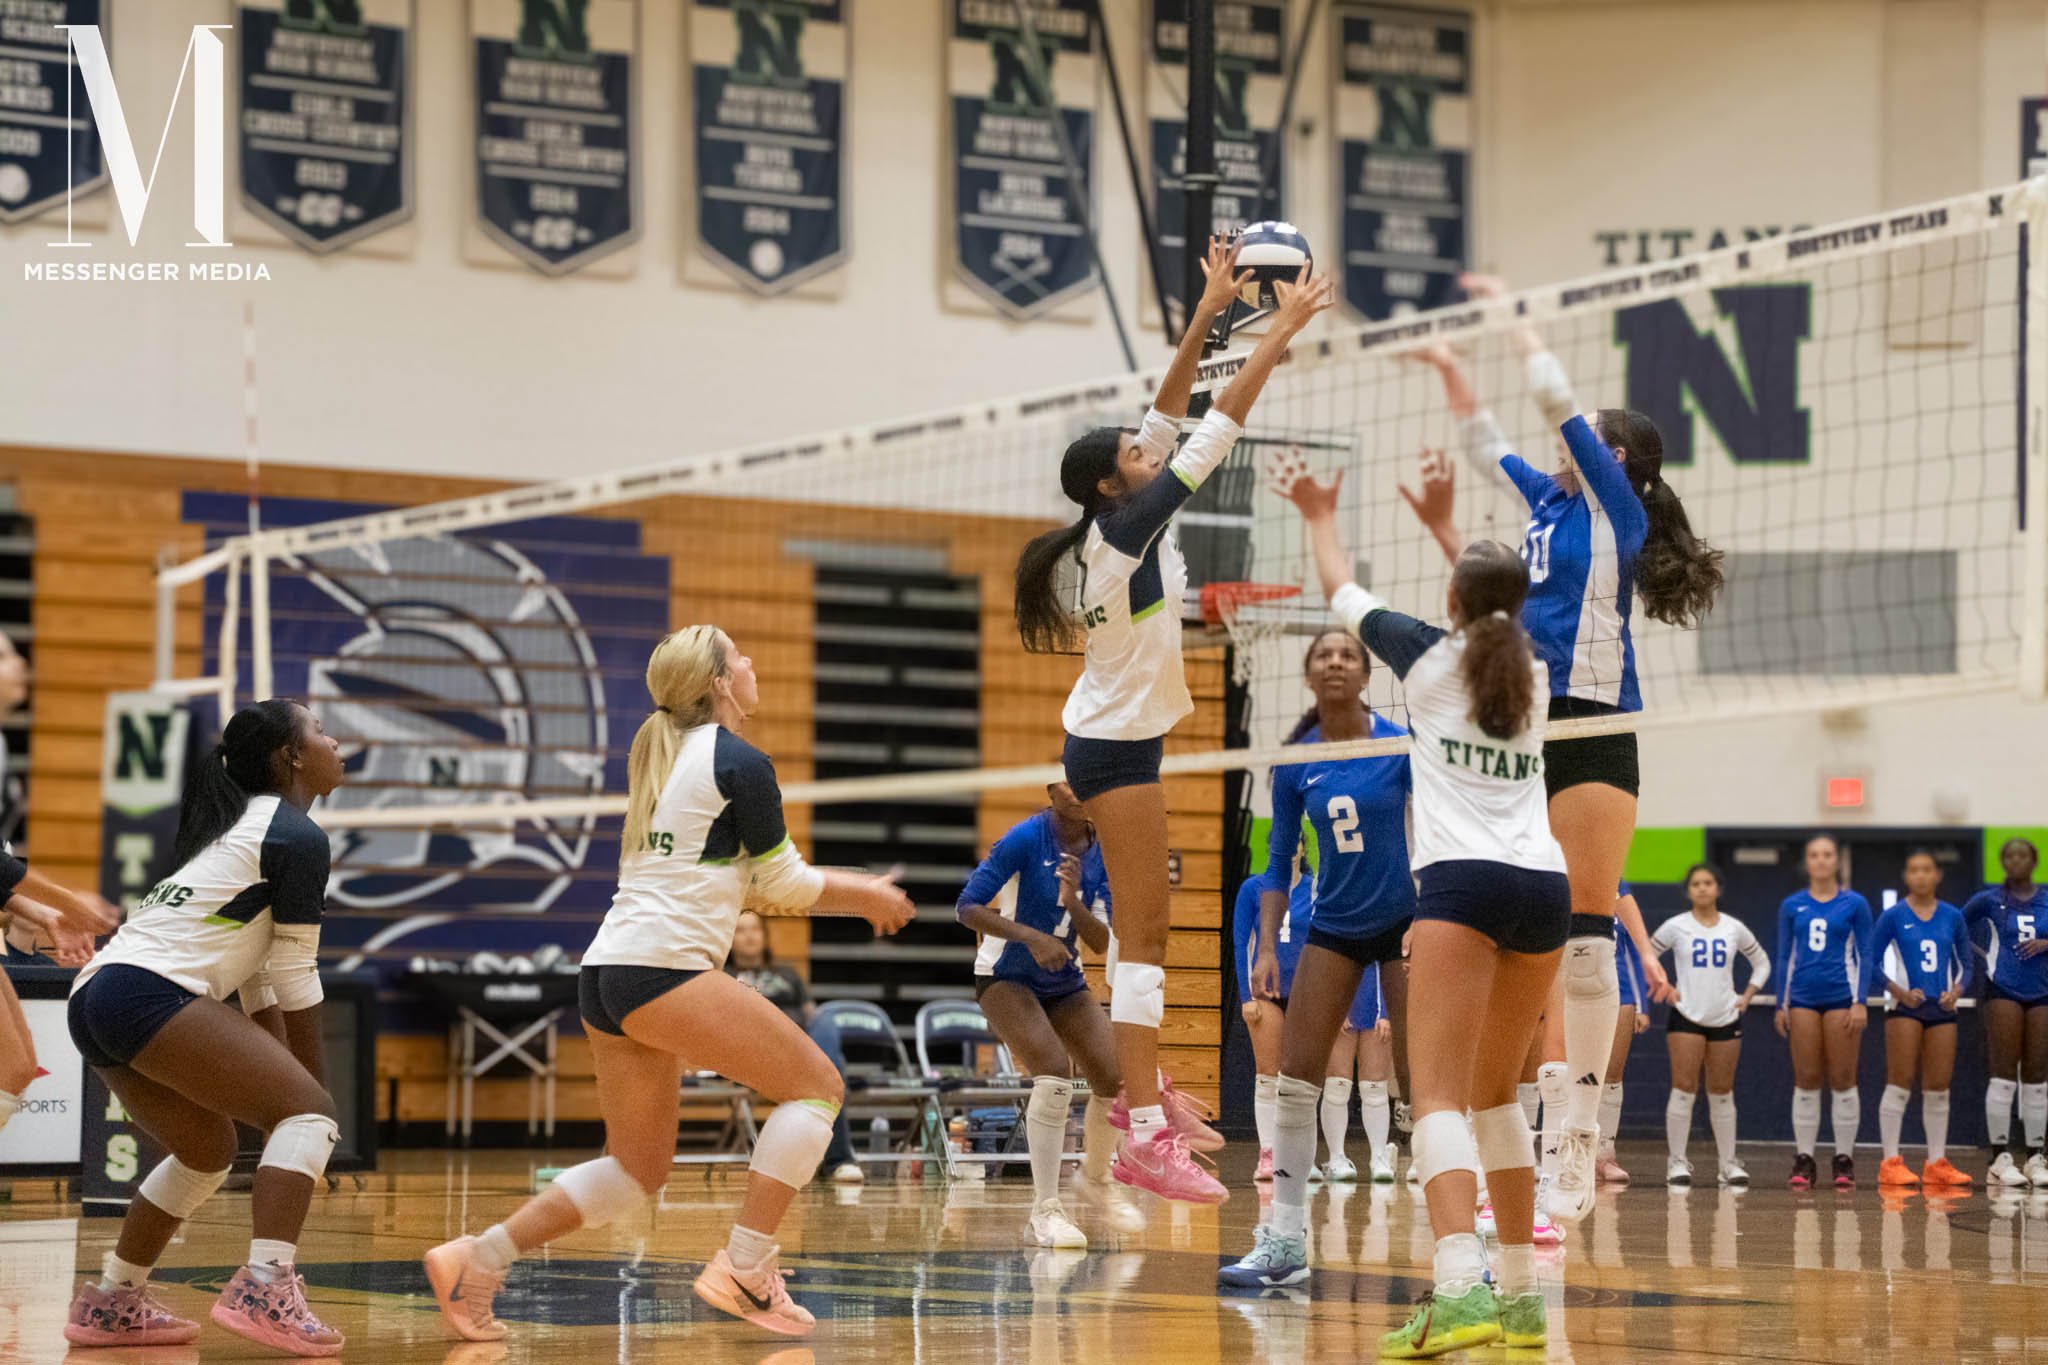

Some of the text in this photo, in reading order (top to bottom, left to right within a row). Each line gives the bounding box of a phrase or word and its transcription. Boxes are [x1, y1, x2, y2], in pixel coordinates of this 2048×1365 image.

[1596, 225, 1813, 265] TITA
[1612, 282, 1812, 466] N
[115, 712, 172, 780] N
[1327, 795, 1364, 854] 2
[1809, 918, 1827, 952] 6
[2016, 916, 2036, 946] 5
[1691, 938, 1727, 968] 26
[1920, 939, 1938, 972] 3
